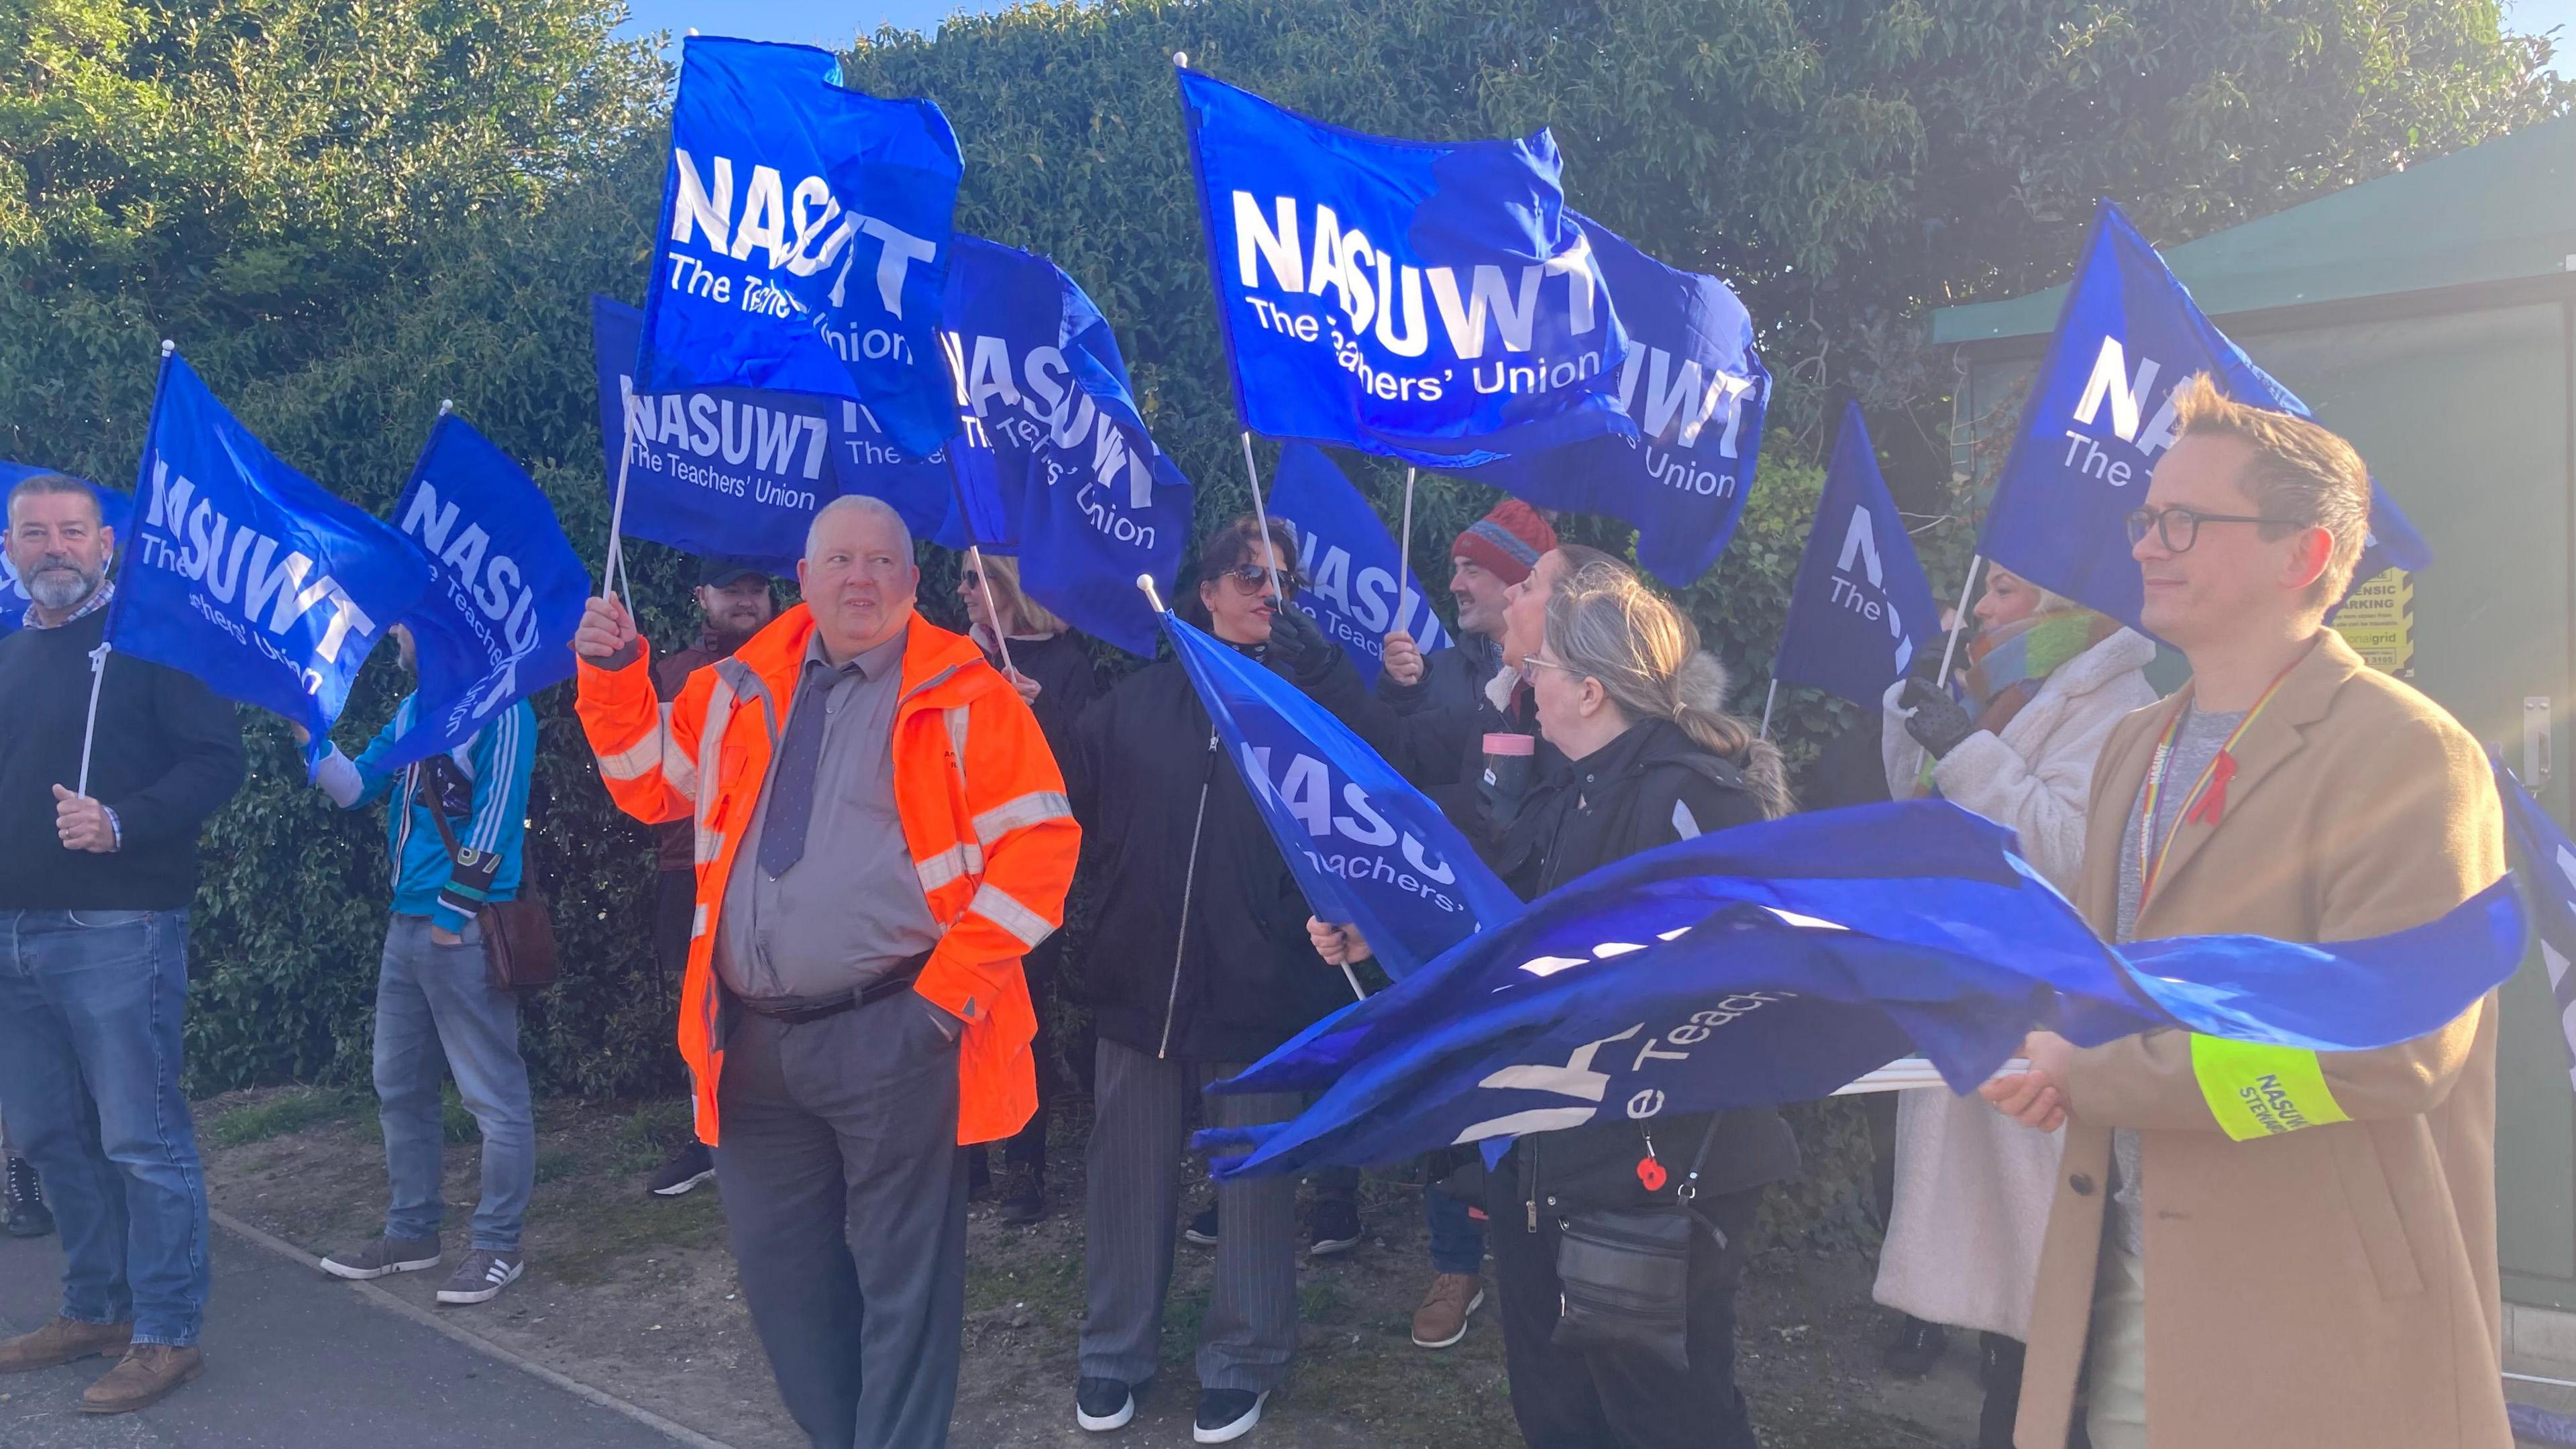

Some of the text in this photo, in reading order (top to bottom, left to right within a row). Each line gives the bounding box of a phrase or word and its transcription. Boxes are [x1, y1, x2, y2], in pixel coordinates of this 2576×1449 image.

[669, 252, 731, 303] The
[1232, 190, 1595, 360] NASUWT
[1245, 296, 1319, 343] The
[1473, 351, 1600, 396] Union
[845, 440, 902, 465] The
[1645, 446, 1736, 498] Union
[2064, 429, 2132, 487] The
[667, 452, 751, 498] Teachers'
[755, 477, 816, 511] Union
[142, 532, 189, 578] The
[1830, 575, 1882, 621] The
[2149, 742, 2169, 785] NASUWT
